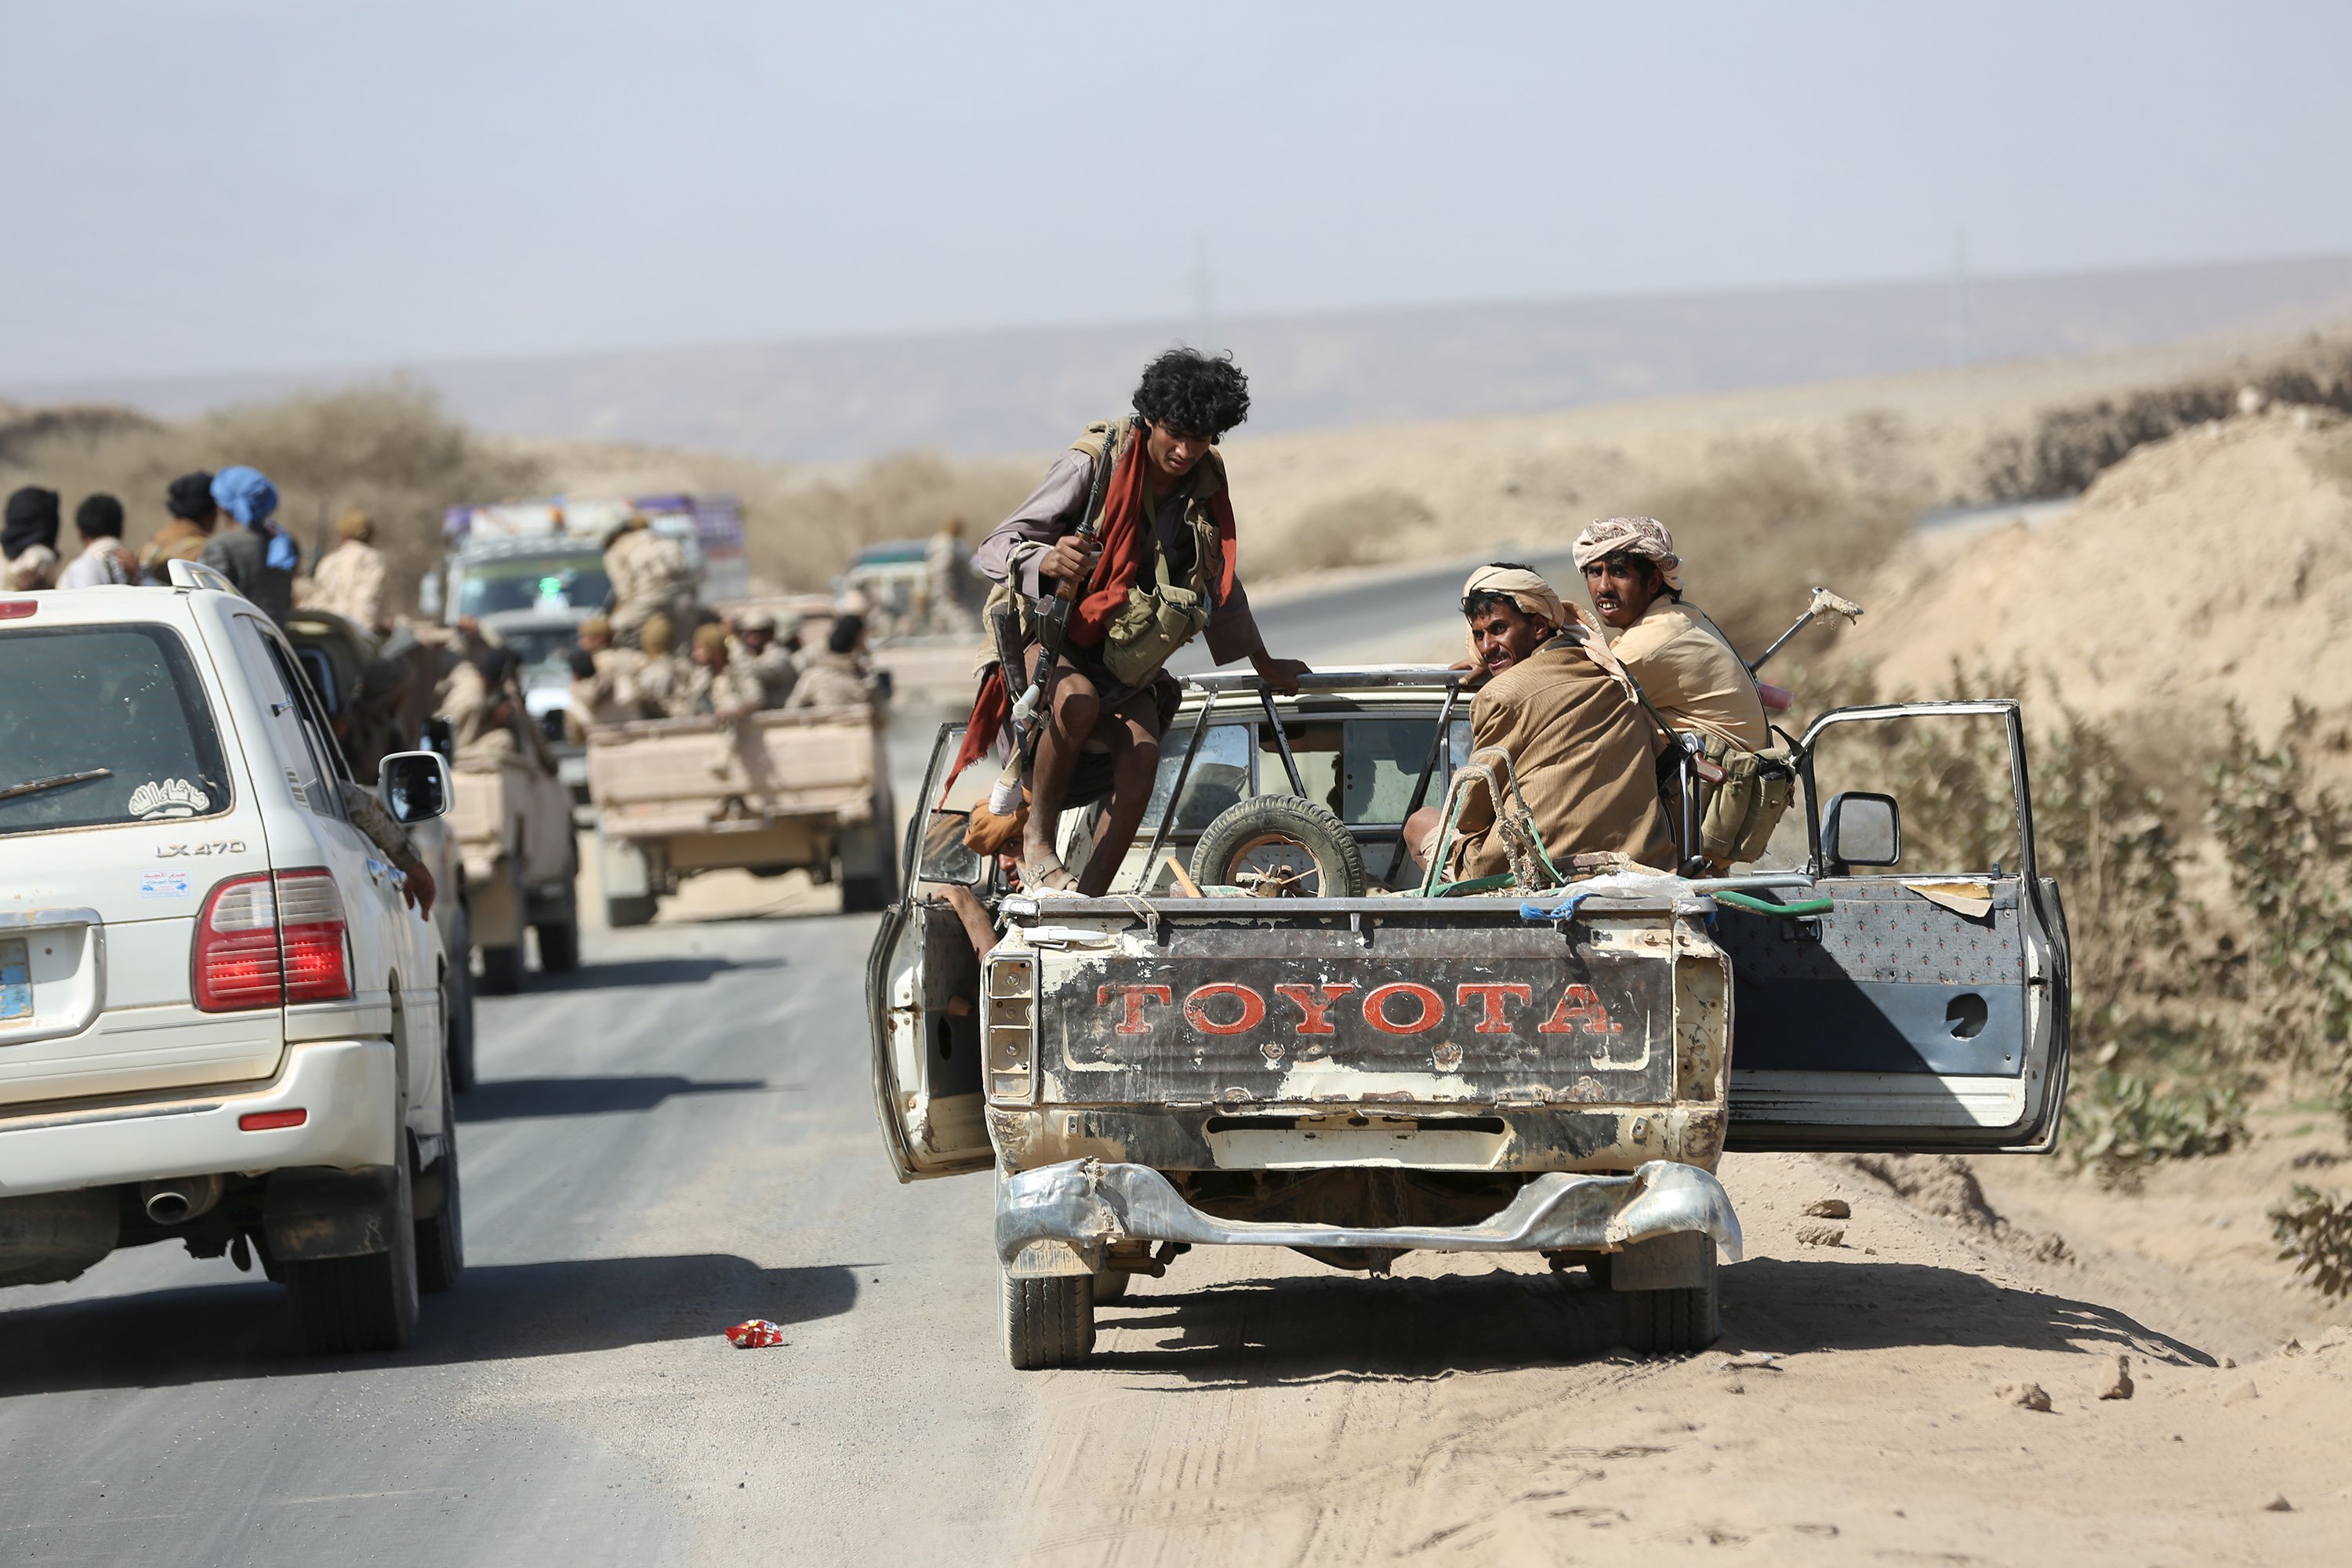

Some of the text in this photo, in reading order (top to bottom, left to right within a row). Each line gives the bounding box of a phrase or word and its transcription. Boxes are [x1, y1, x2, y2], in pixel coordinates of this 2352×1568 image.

[154, 839, 246, 858] LX 470
[1097, 982, 1624, 1035] TOYOTA
